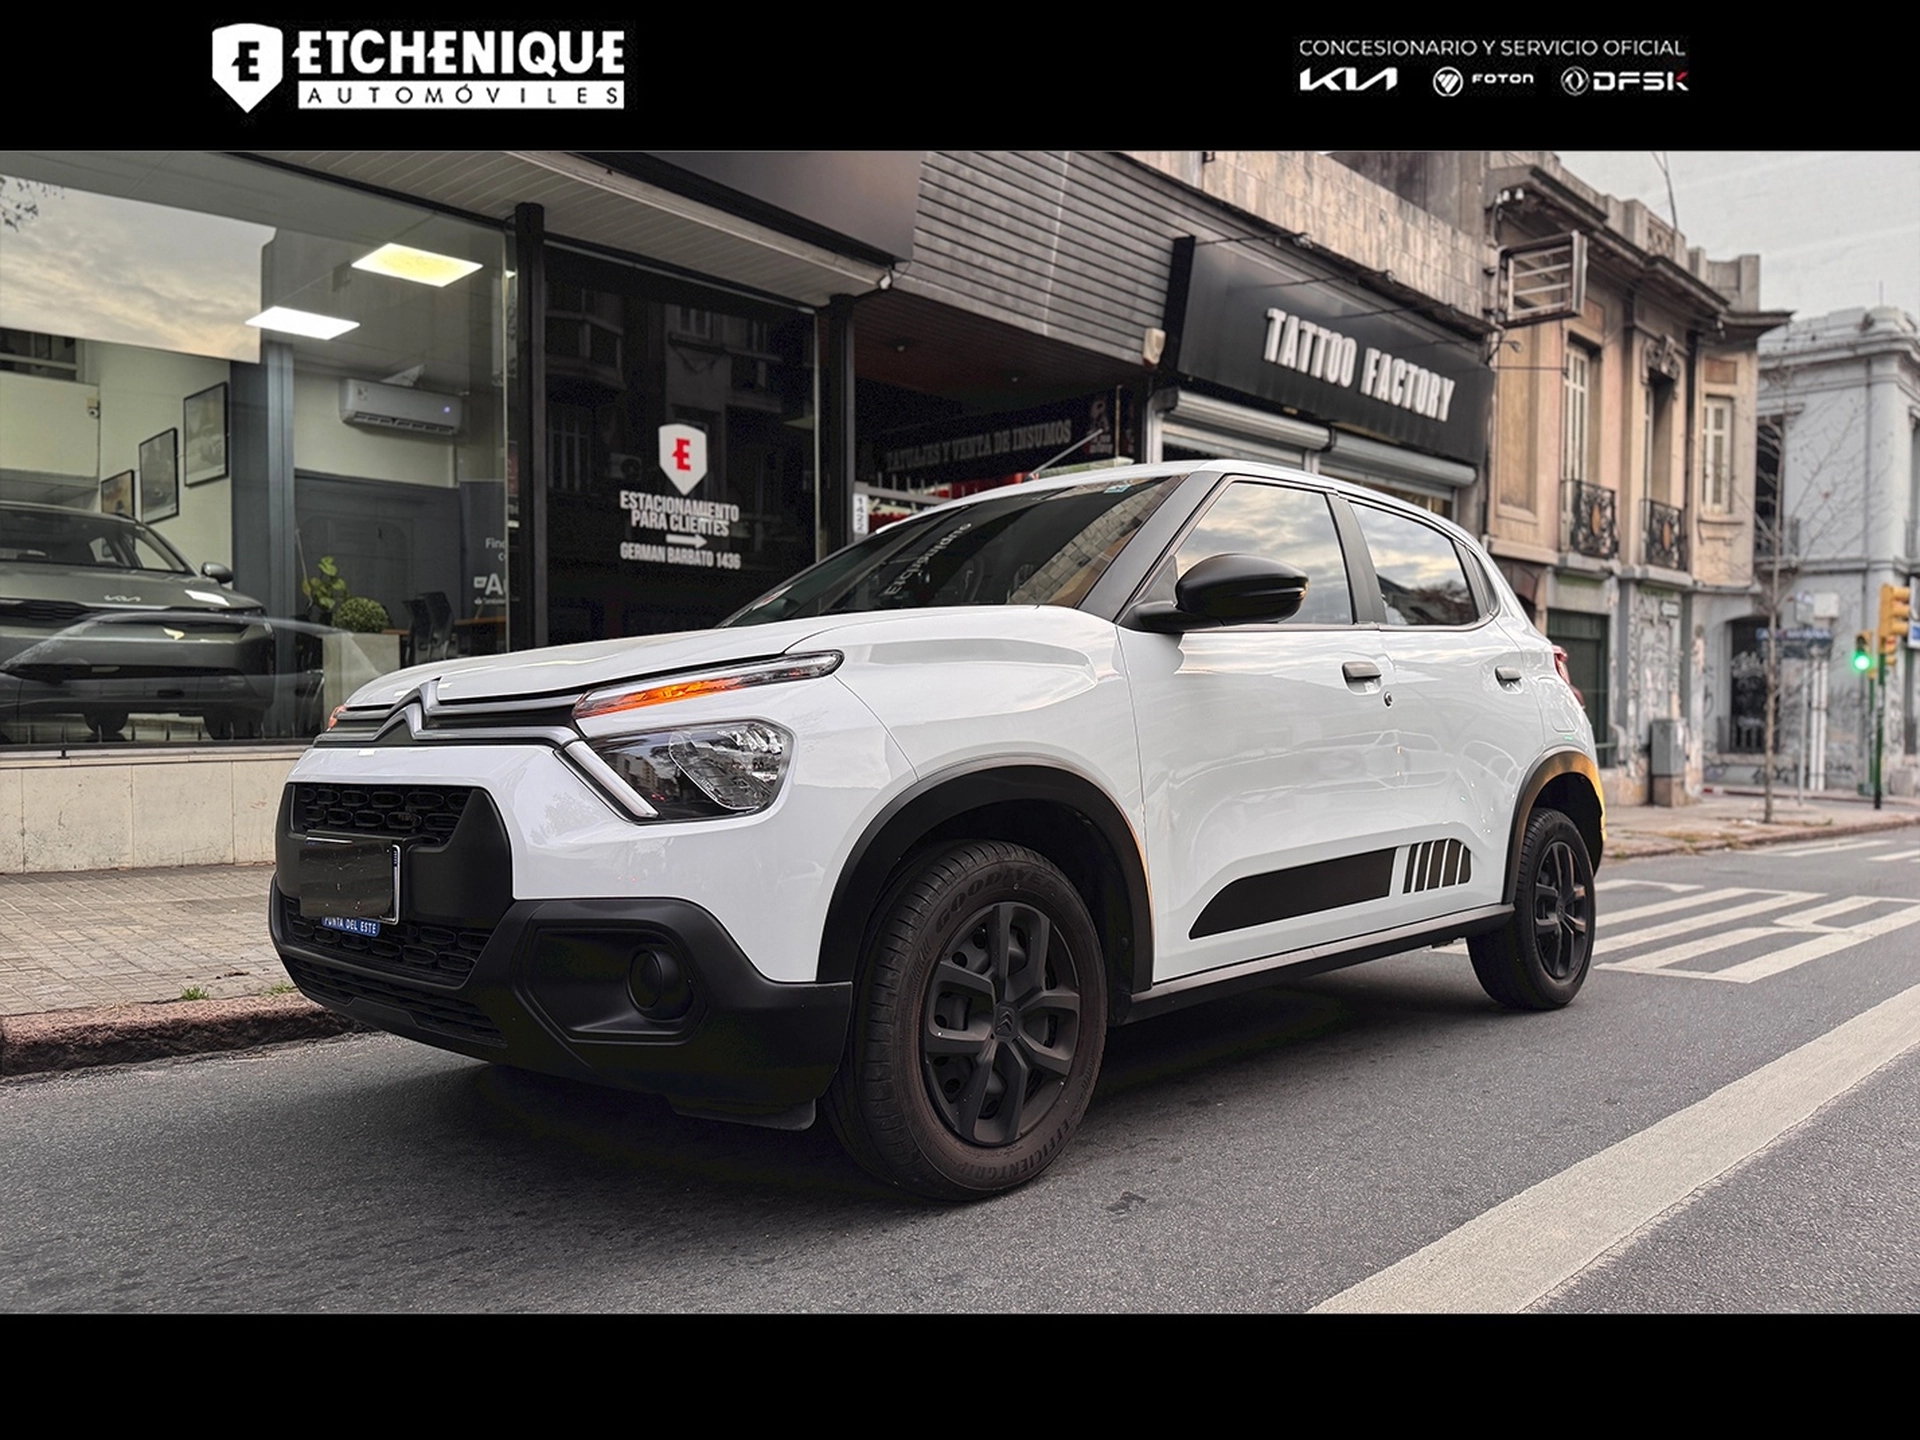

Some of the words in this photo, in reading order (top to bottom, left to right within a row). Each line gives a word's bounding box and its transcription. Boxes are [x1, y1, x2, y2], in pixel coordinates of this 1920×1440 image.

[1263, 307, 1357, 388] TATTOO
[1360, 347, 1455, 422] FACTORY
[952, 433, 992, 461] VENTA
[993, 430, 1011, 454] DE
[1012, 419, 1072, 451] INSUMOS
[620, 490, 740, 522] ESTACIONAMIENTO
[631, 509, 668, 531] PARA
[669, 514, 730, 537] CLIENTES
[620, 541, 667, 563] GERMAN
[667, 546, 714, 568] BARBATO
[346, 918, 358, 931] DEL
[360, 921, 377, 934] ESTE
